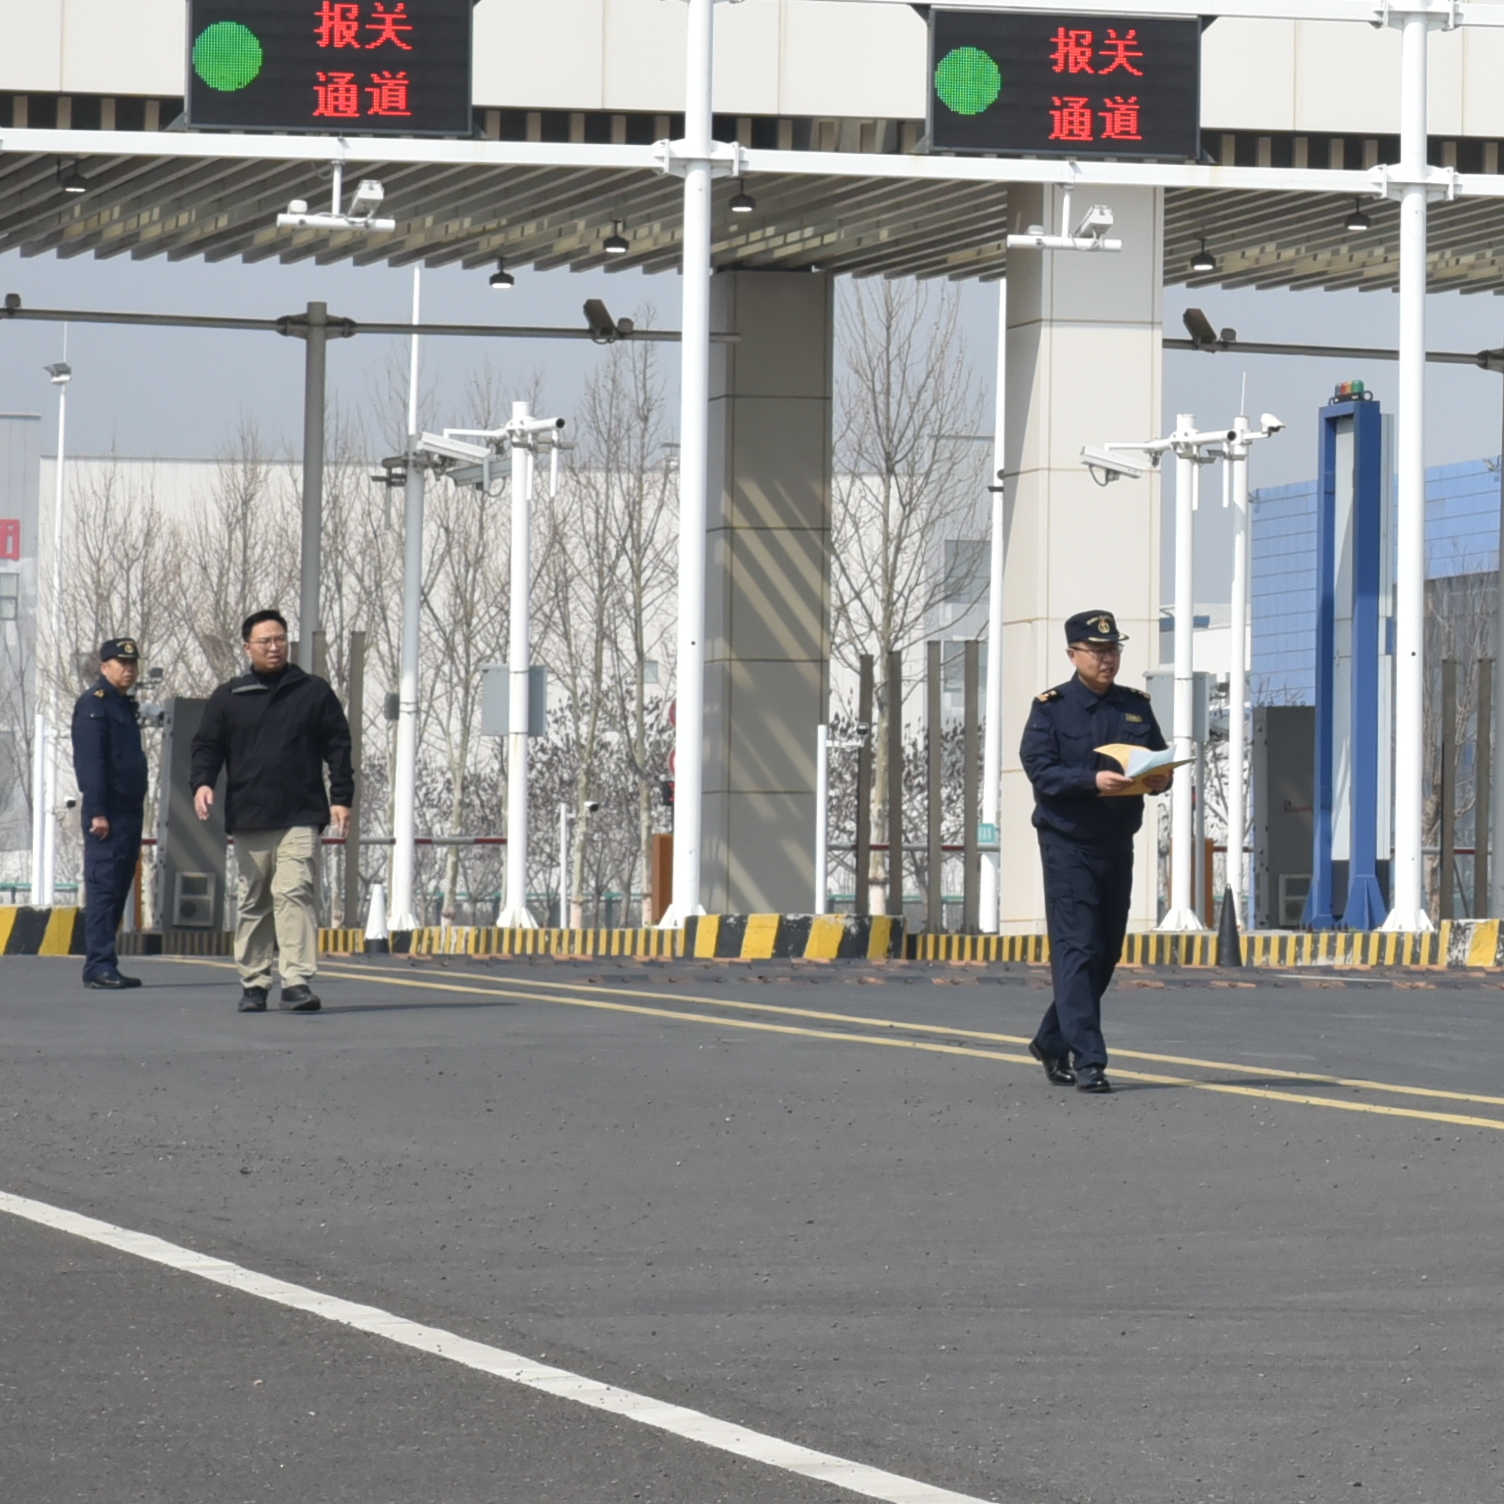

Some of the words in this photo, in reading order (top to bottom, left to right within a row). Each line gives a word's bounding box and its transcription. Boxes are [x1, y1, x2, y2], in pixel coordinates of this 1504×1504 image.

[312, 0, 414, 50] 报关
[1048, 26, 1145, 76] 报关
[311, 69, 413, 119] 通道
[1047, 95, 1144, 142] 通道
